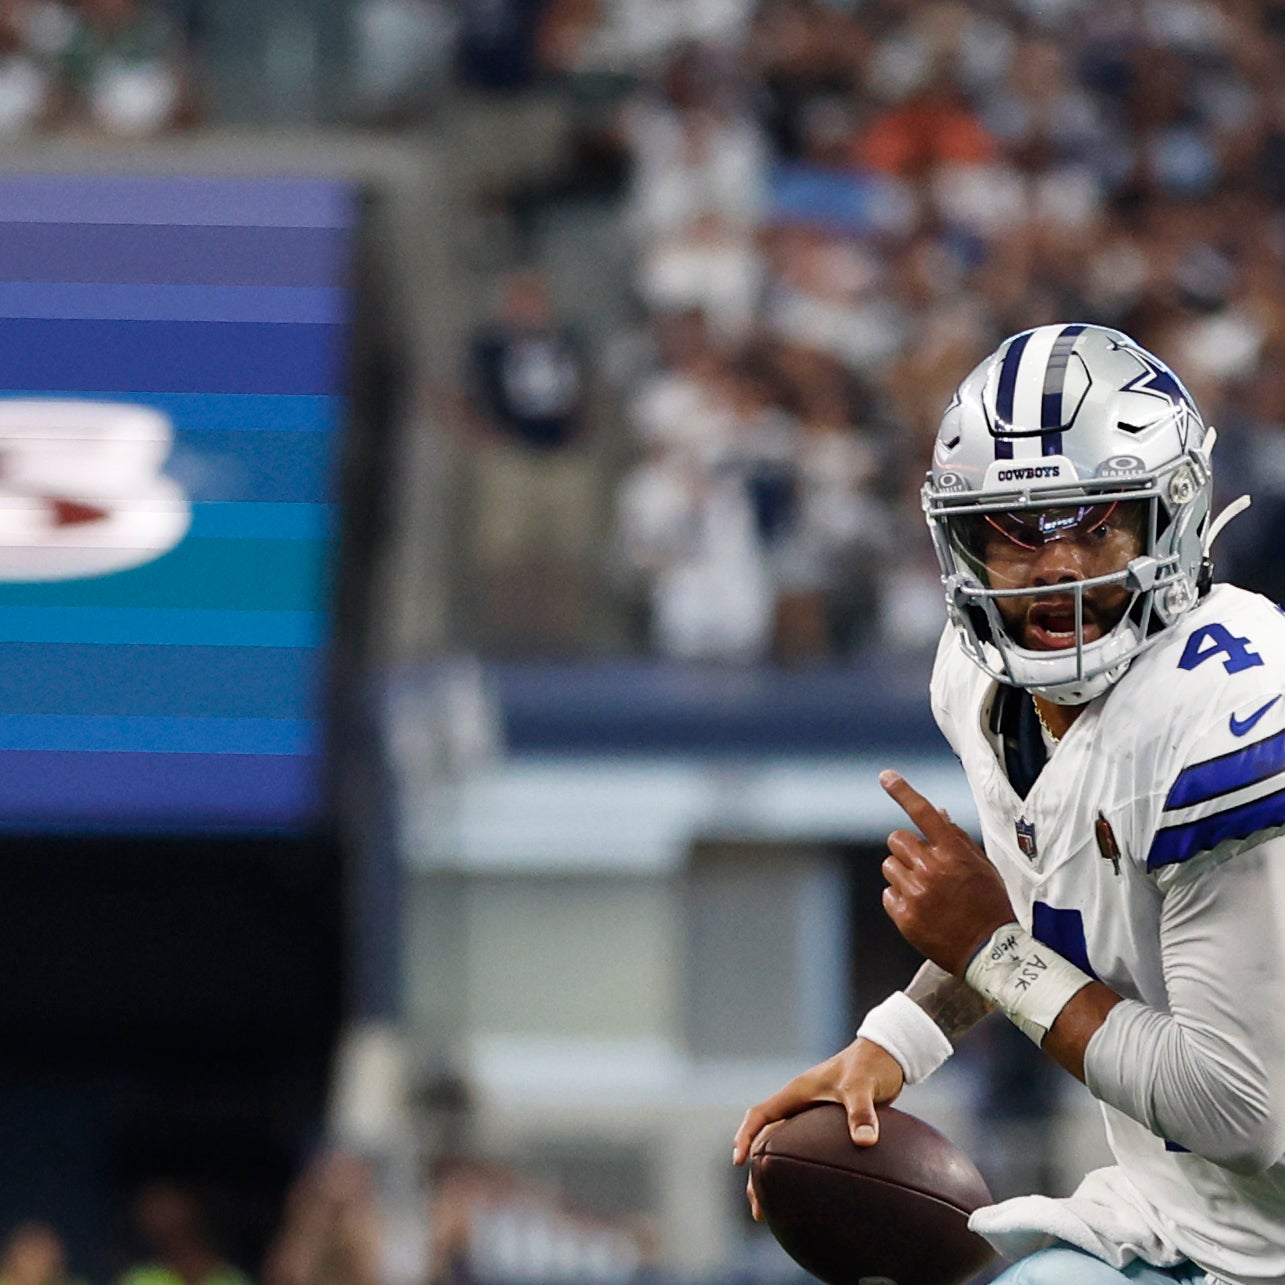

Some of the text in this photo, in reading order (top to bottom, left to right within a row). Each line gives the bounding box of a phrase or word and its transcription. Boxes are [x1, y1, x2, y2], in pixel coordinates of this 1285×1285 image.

[998, 466, 1060, 482] COWBOYS
[1177, 622, 1265, 676] 4
[1015, 954, 1048, 991] ASK
